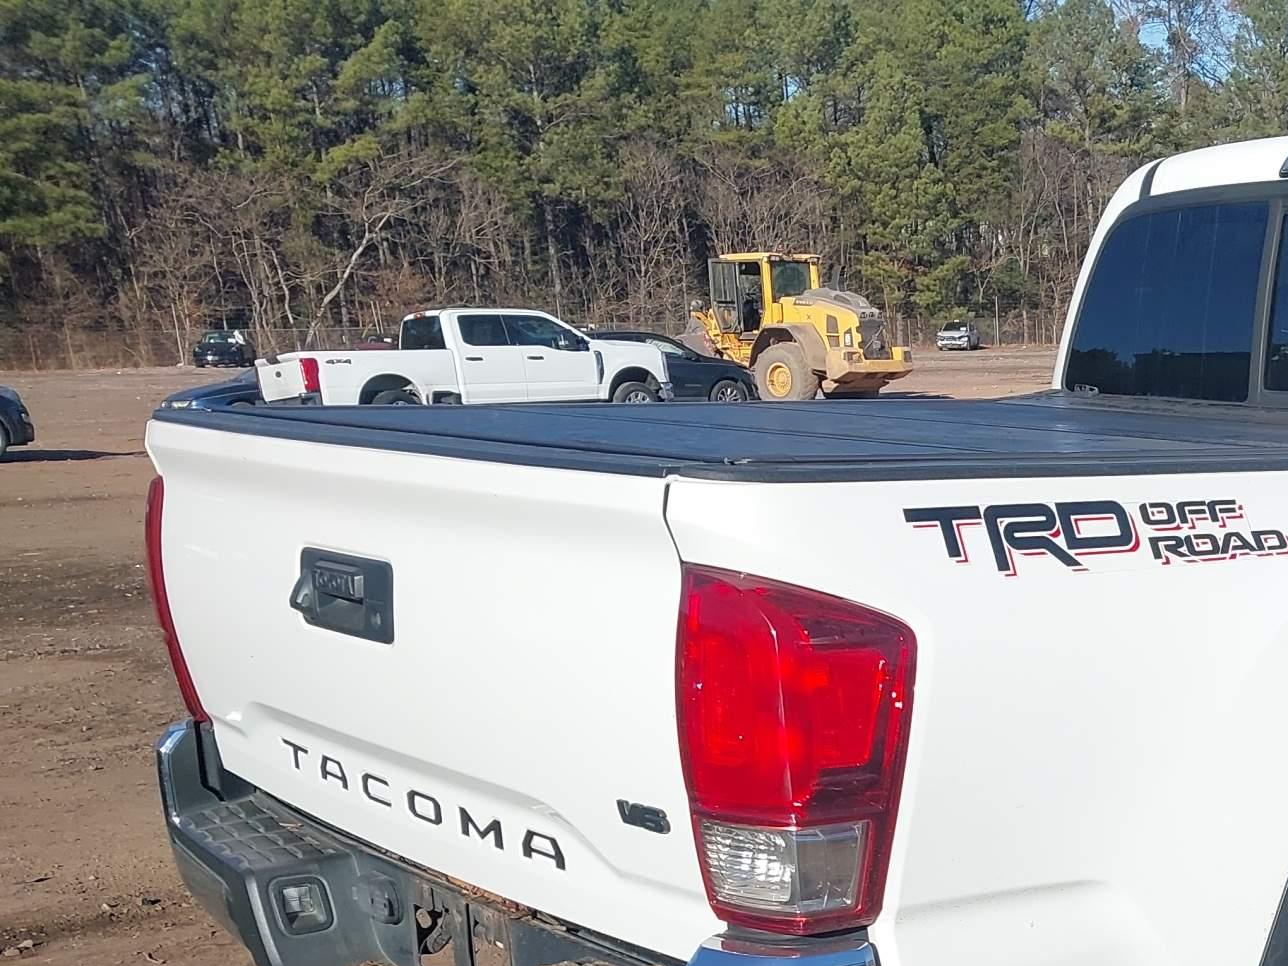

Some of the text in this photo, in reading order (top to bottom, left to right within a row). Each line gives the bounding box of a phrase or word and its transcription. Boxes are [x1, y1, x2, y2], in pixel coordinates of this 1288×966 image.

[902, 499, 1140, 577] TRD
[1139, 499, 1244, 531] OFF
[280, 738, 567, 871] TACOMA
[616, 799, 671, 834] V6
